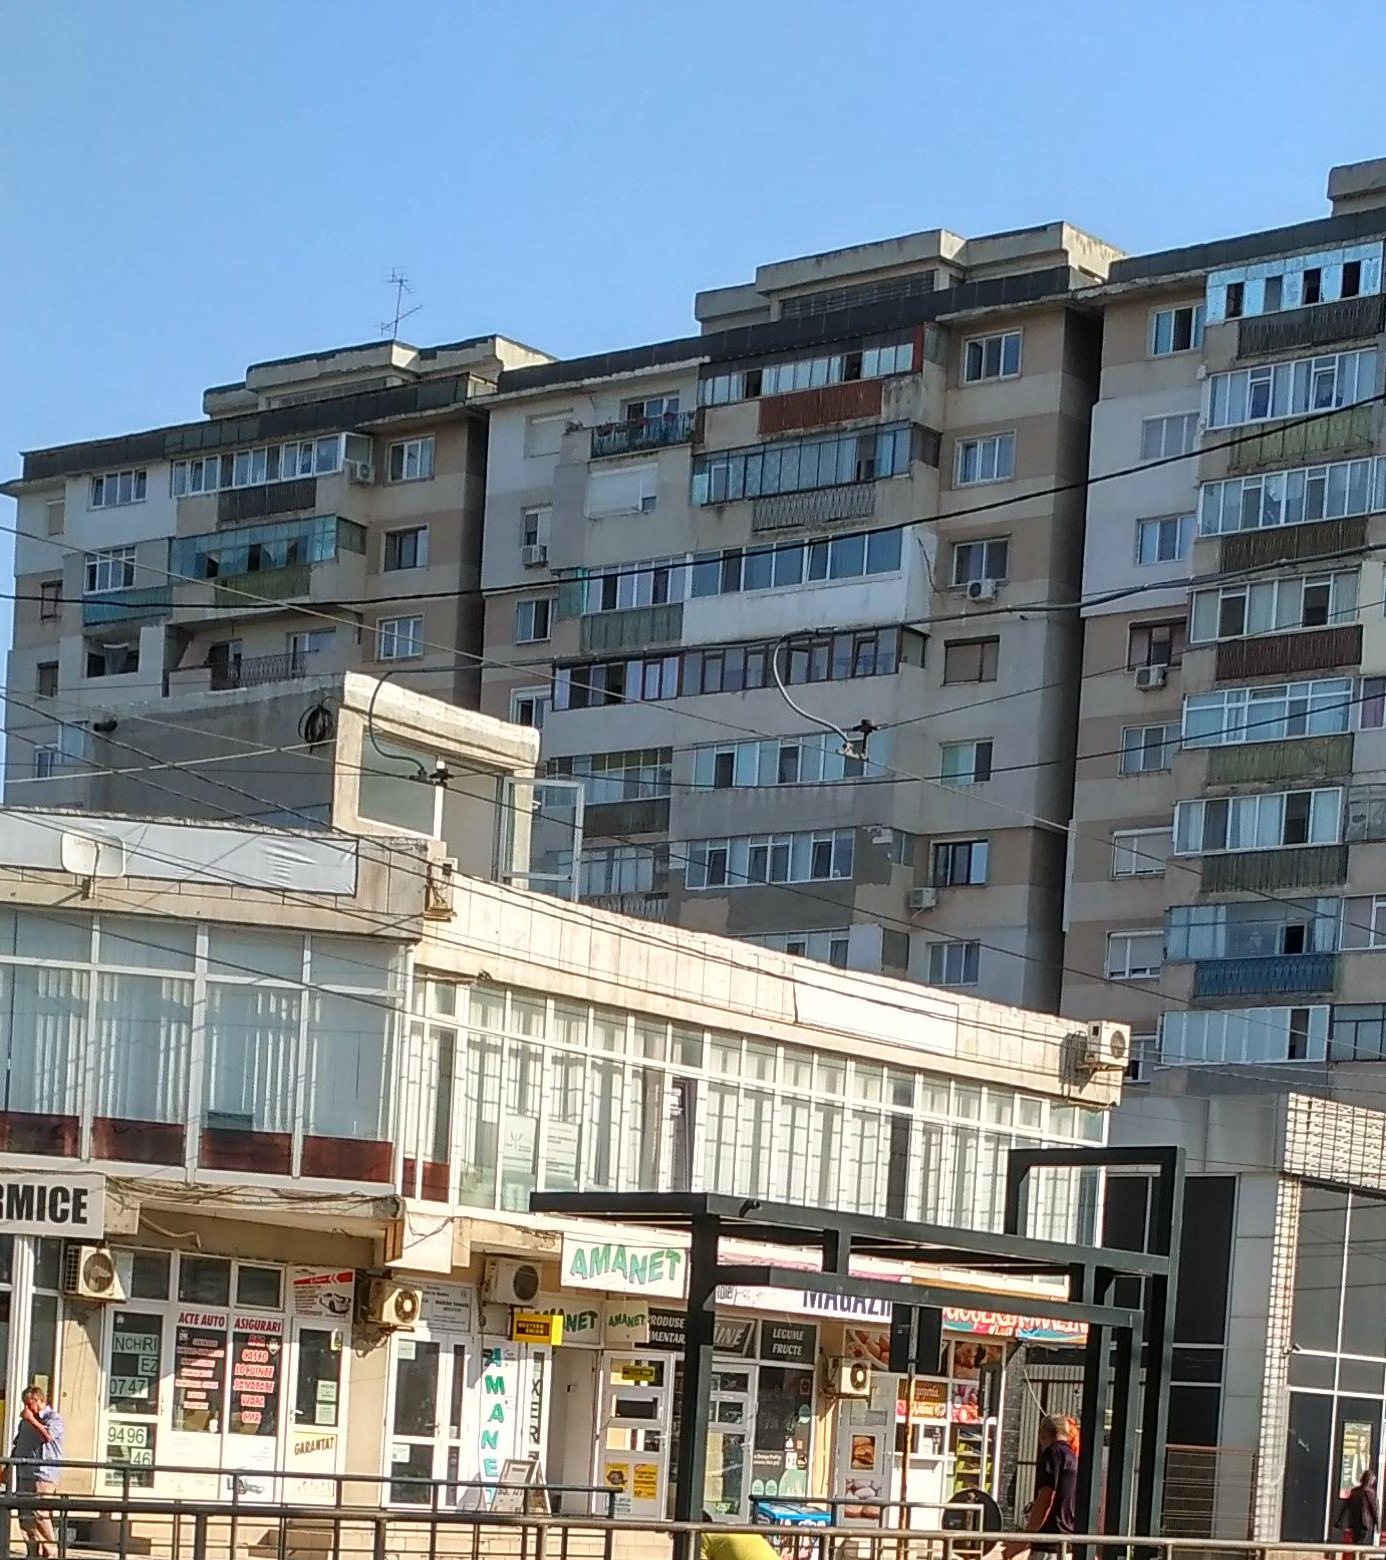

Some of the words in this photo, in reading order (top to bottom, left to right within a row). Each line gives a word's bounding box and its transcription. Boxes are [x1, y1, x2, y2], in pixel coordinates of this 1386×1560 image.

[570, 1243, 681, 1285] AMANET
[178, 1312, 199, 1325] ACTE
[200, 1314, 225, 1328] AUTO
[234, 1317, 281, 1332] ASIGURARI
[609, 1313, 646, 1328] AMANET
[772, 1328, 804, 1342] LEGUME
[772, 1343, 803, 1355] FRUCTE
[110, 1379, 146, 1395] 0747
[108, 1426, 145, 1444] 9496
